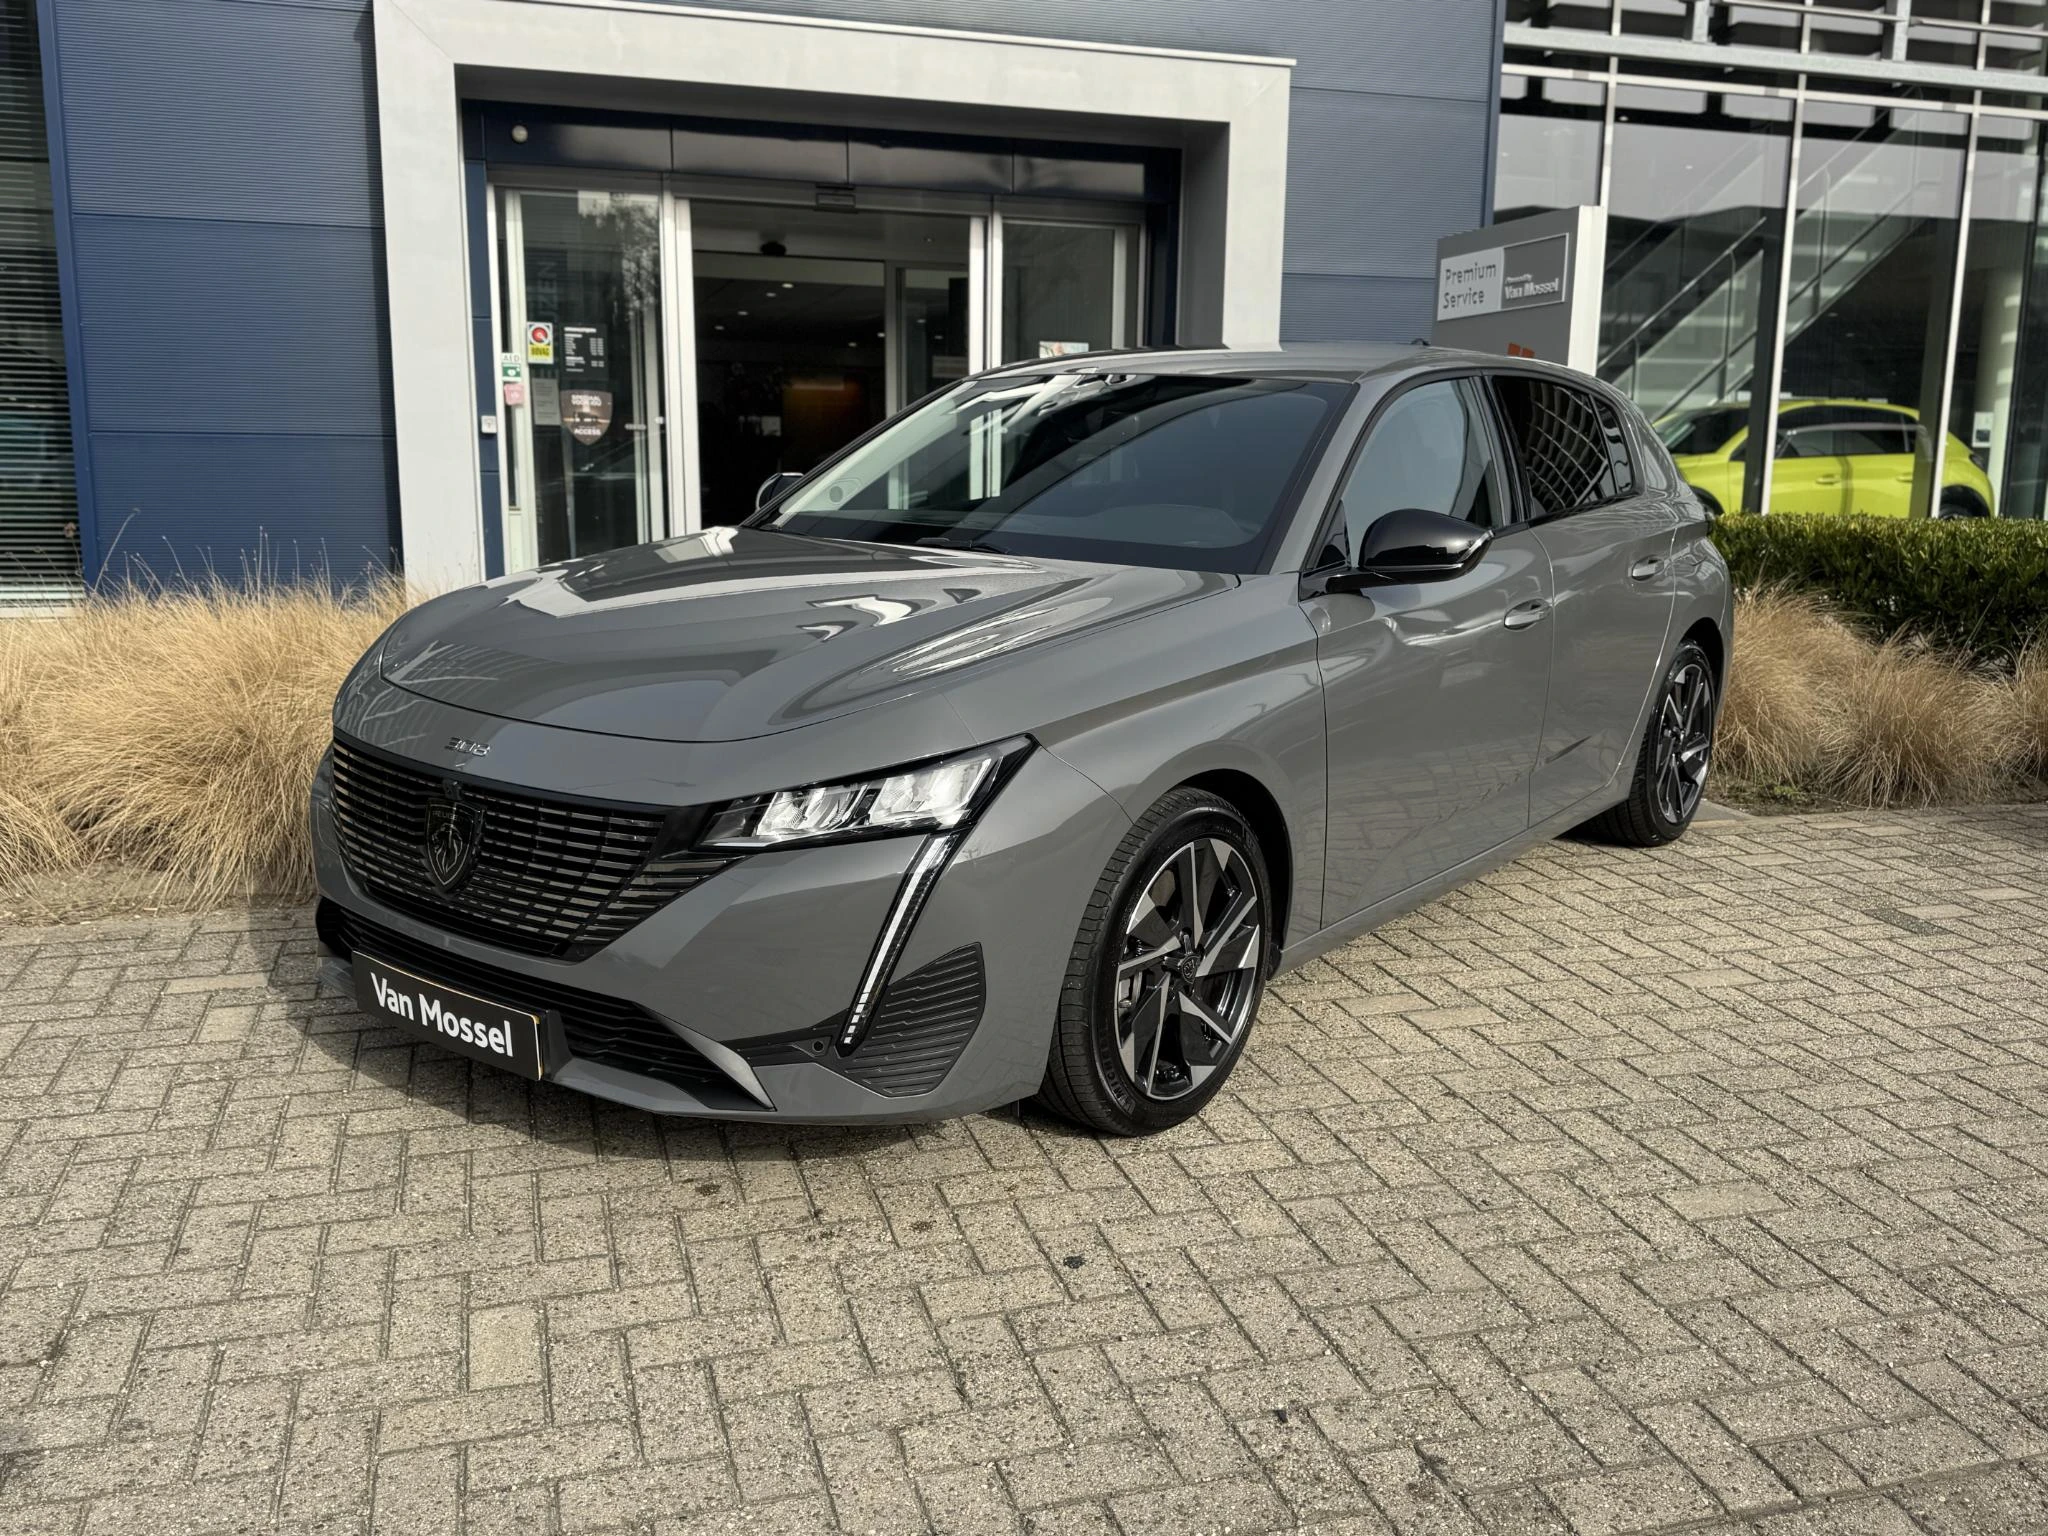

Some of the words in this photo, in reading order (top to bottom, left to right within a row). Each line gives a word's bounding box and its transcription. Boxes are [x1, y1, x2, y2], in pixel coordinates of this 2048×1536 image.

[1445, 262, 1496, 285] Premium
[1443, 288, 1485, 309] Service
[1504, 285, 1523, 299] Van
[1524, 278, 1560, 297] Mossel
[574, 428, 602, 436] ACCESS
[445, 736, 491, 757] 308
[370, 971, 414, 1021] Van
[418, 993, 514, 1057] Mossel
